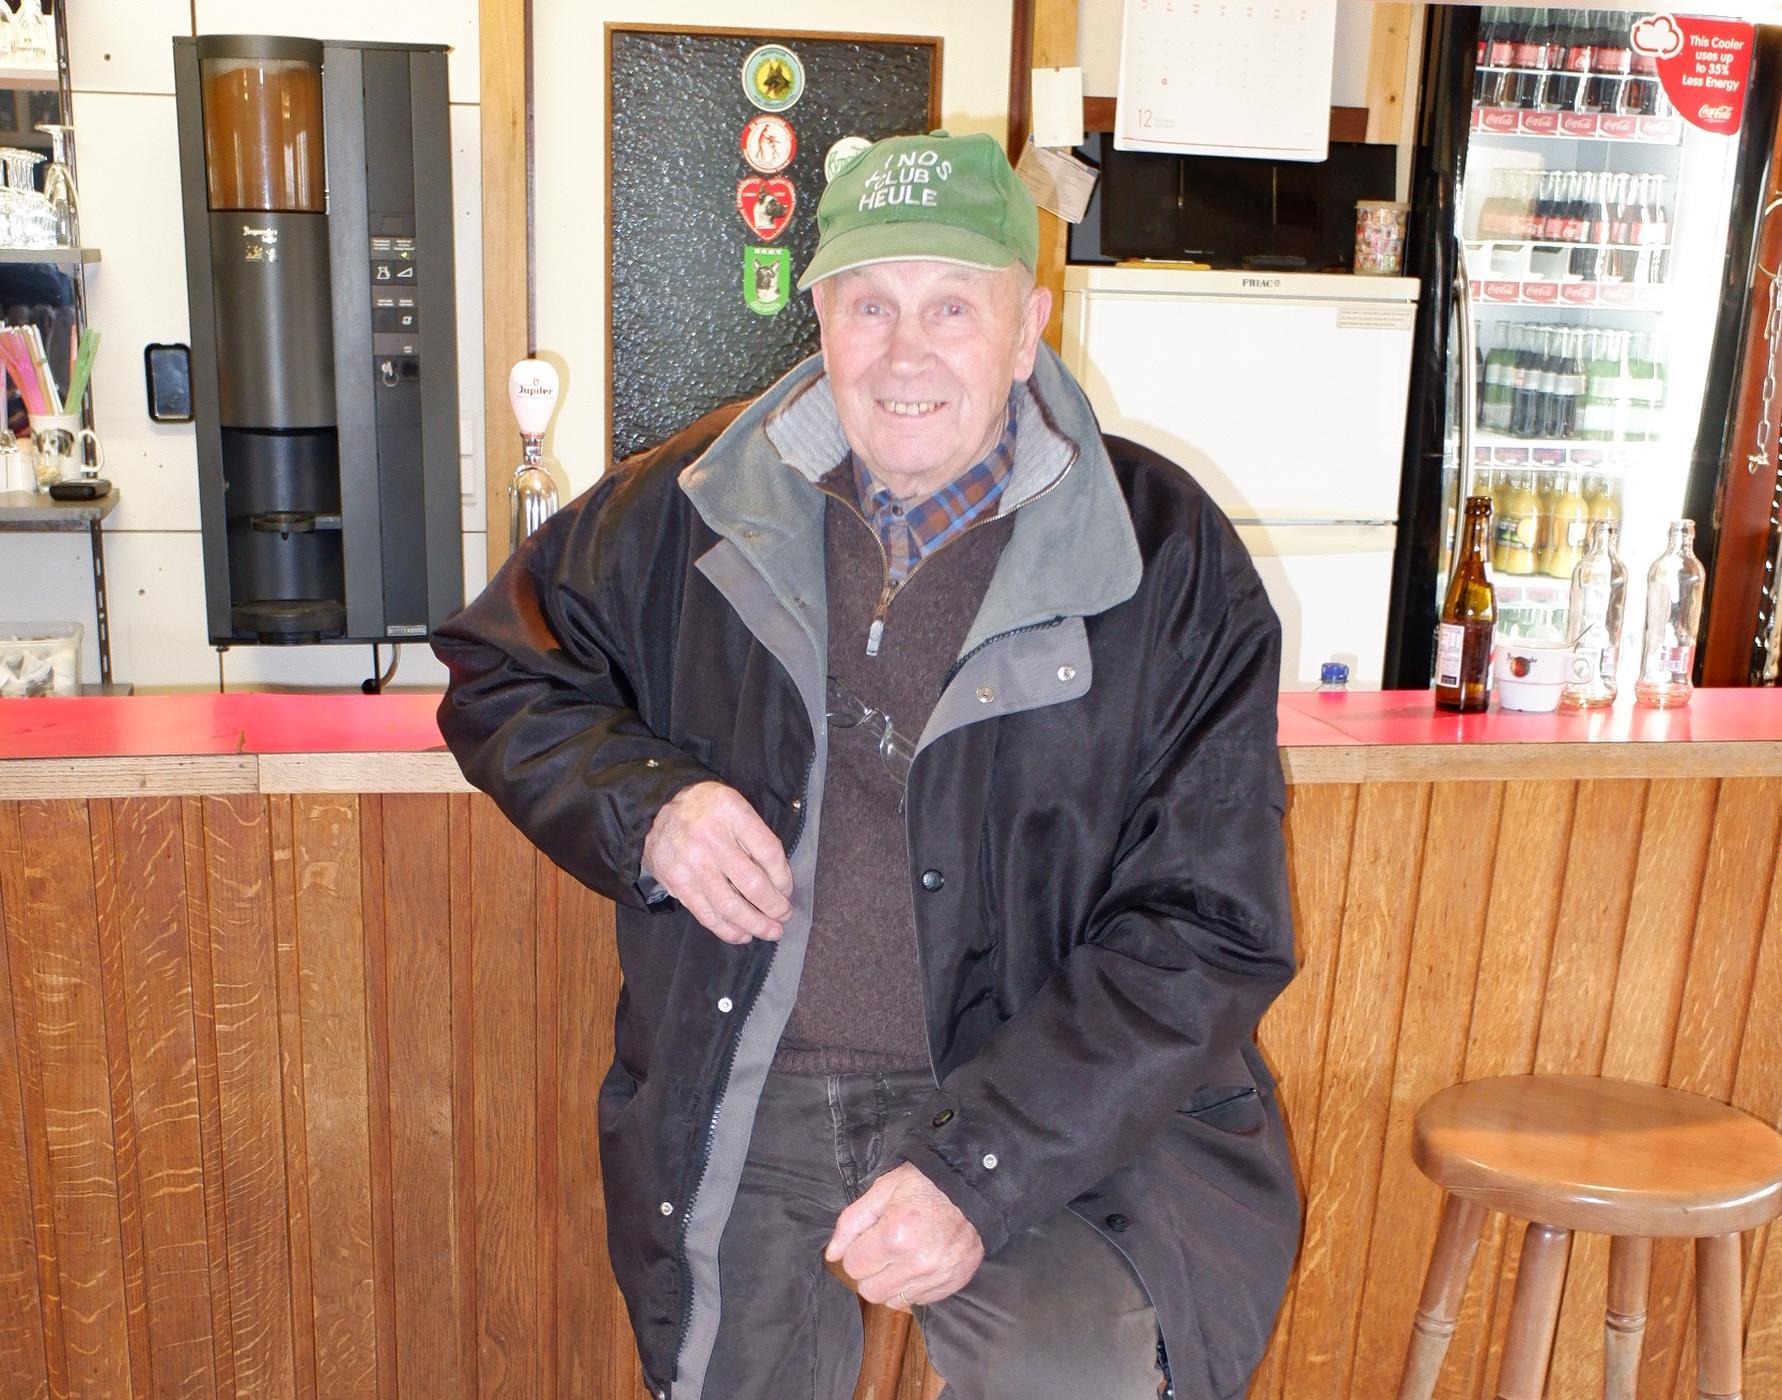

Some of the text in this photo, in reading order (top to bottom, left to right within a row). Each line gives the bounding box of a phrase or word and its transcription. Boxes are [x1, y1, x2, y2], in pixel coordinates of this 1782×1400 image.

[1689, 33, 1744, 50] This Cooler
[1695, 51, 1734, 64] uses up
[1695, 62, 1730, 76] to 35%
[1681, 74, 1740, 92] Less Energy
[1138, 109, 1152, 128] 12
[859, 185, 938, 212] HEULE
[1242, 278, 1274, 288] FRIAC
[518, 385, 553, 396] Jupiler
